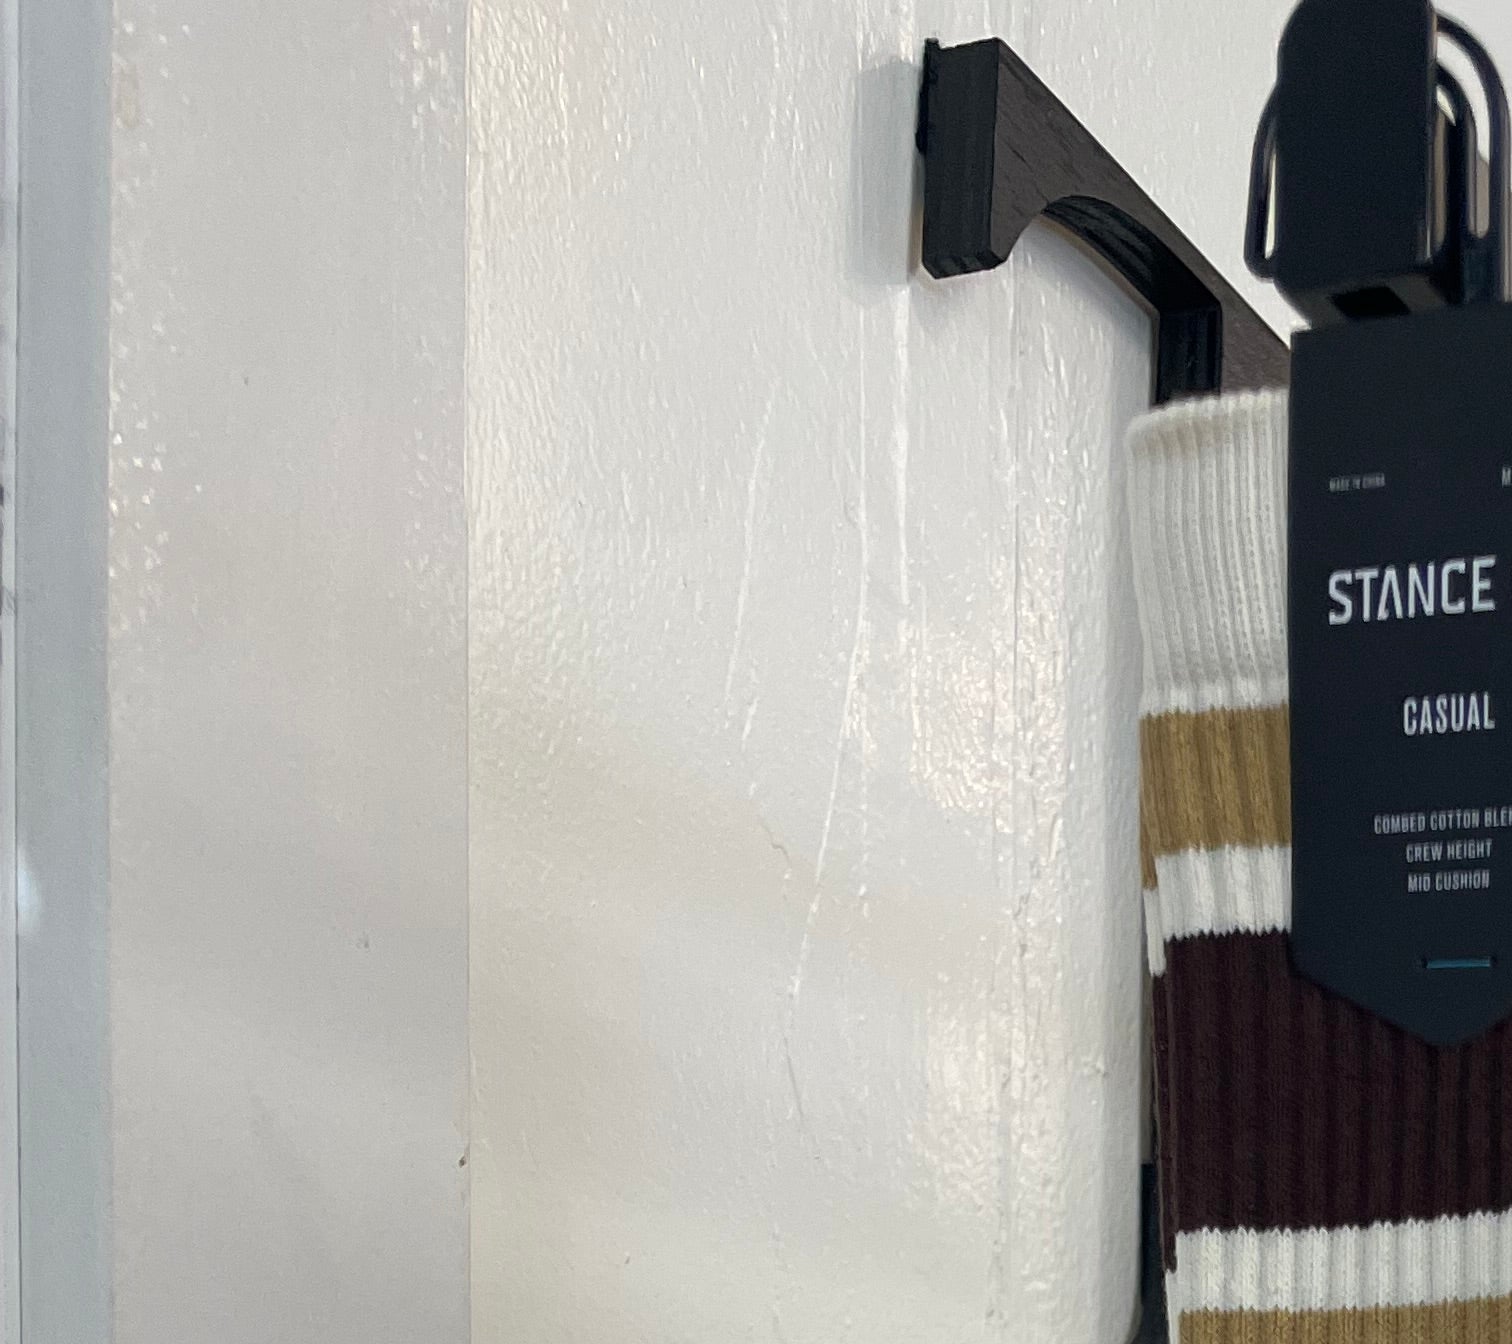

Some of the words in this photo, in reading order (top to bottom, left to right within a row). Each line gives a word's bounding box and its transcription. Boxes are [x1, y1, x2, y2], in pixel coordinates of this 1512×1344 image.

[1328, 555, 1496, 626] STANCE
[1403, 691, 1496, 736] CASUAL
[1374, 812, 1426, 835] COMBED
[1430, 808, 1480, 831] COTTON
[1406, 841, 1443, 863] CREW
[1446, 838, 1493, 861] HEIGHT
[1408, 872, 1431, 893] MID
[1435, 869, 1491, 891] CUSHION
